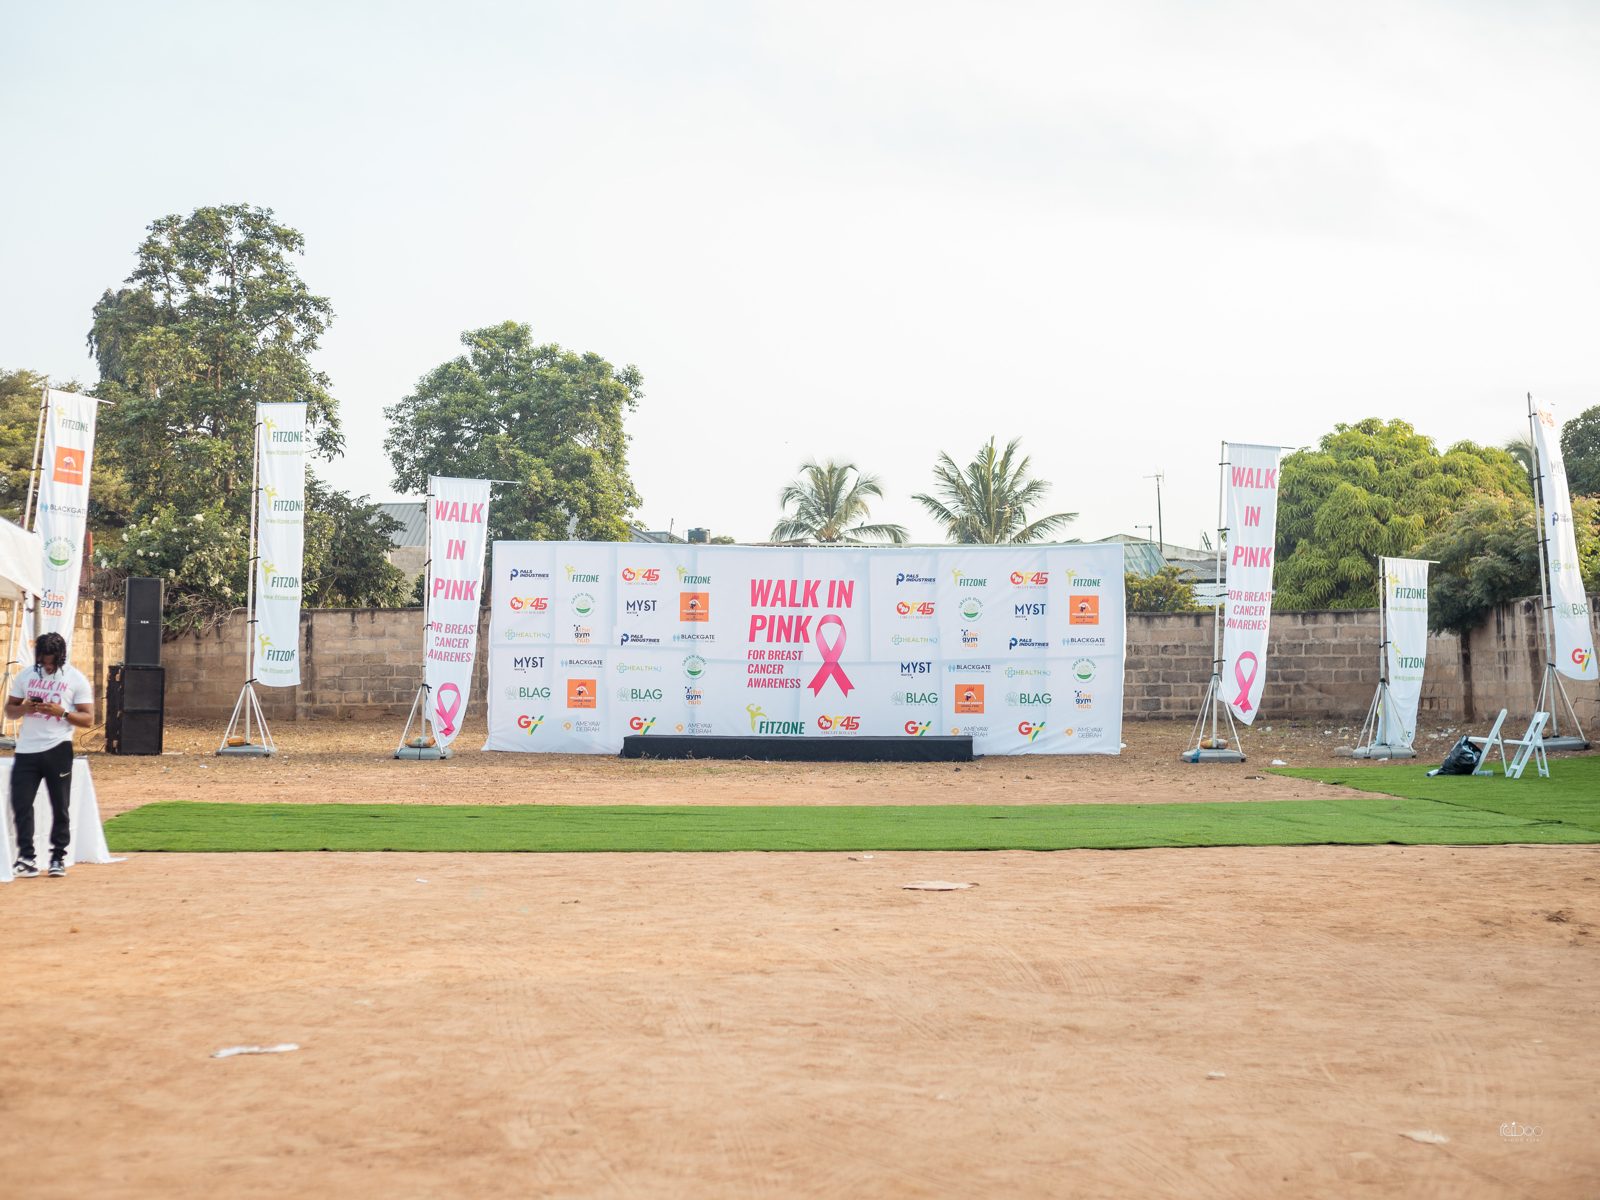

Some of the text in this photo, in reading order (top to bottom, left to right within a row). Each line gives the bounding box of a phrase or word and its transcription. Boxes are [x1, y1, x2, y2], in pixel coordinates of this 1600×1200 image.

[62, 418, 89, 433] FITZONE
[272, 431, 304, 443] FITZONE
[1231, 465, 1276, 489] WALK
[435, 499, 484, 524] WALK
[1244, 505, 1261, 527] IN
[445, 539, 466, 560] IN
[1232, 545, 1273, 568] PINK
[572, 574, 600, 583] FITZONE
[683, 575, 711, 584] FITZONE
[959, 578, 987, 587] FITZONE
[1072, 578, 1101, 587] FITZONE
[433, 577, 477, 601] PINK
[750, 579, 854, 609] WALK IN
[1395, 587, 1427, 600] FITZONE
[48, 593, 64, 601] the
[41, 600, 63, 609] gym
[626, 600, 657, 611] MYST
[1015, 603, 1046, 615] MYST
[1233, 604, 1266, 616] CANCER
[44, 608, 62, 617] hub
[748, 614, 812, 643] PINK
[434, 636, 469, 649] CANCER
[747, 649, 803, 661] FOR BREAST
[514, 656, 545, 668] MYST
[900, 661, 932, 674] MYST
[747, 663, 784, 675] CANCER
[28, 678, 68, 692] WALK IN
[747, 677, 801, 689] AWARENESS
[519, 686, 551, 698] BLAG
[631, 688, 663, 700] BLAG
[906, 692, 938, 704] BLAG
[1019, 692, 1052, 704] BLAG
[758, 721, 806, 735] FITZONE
